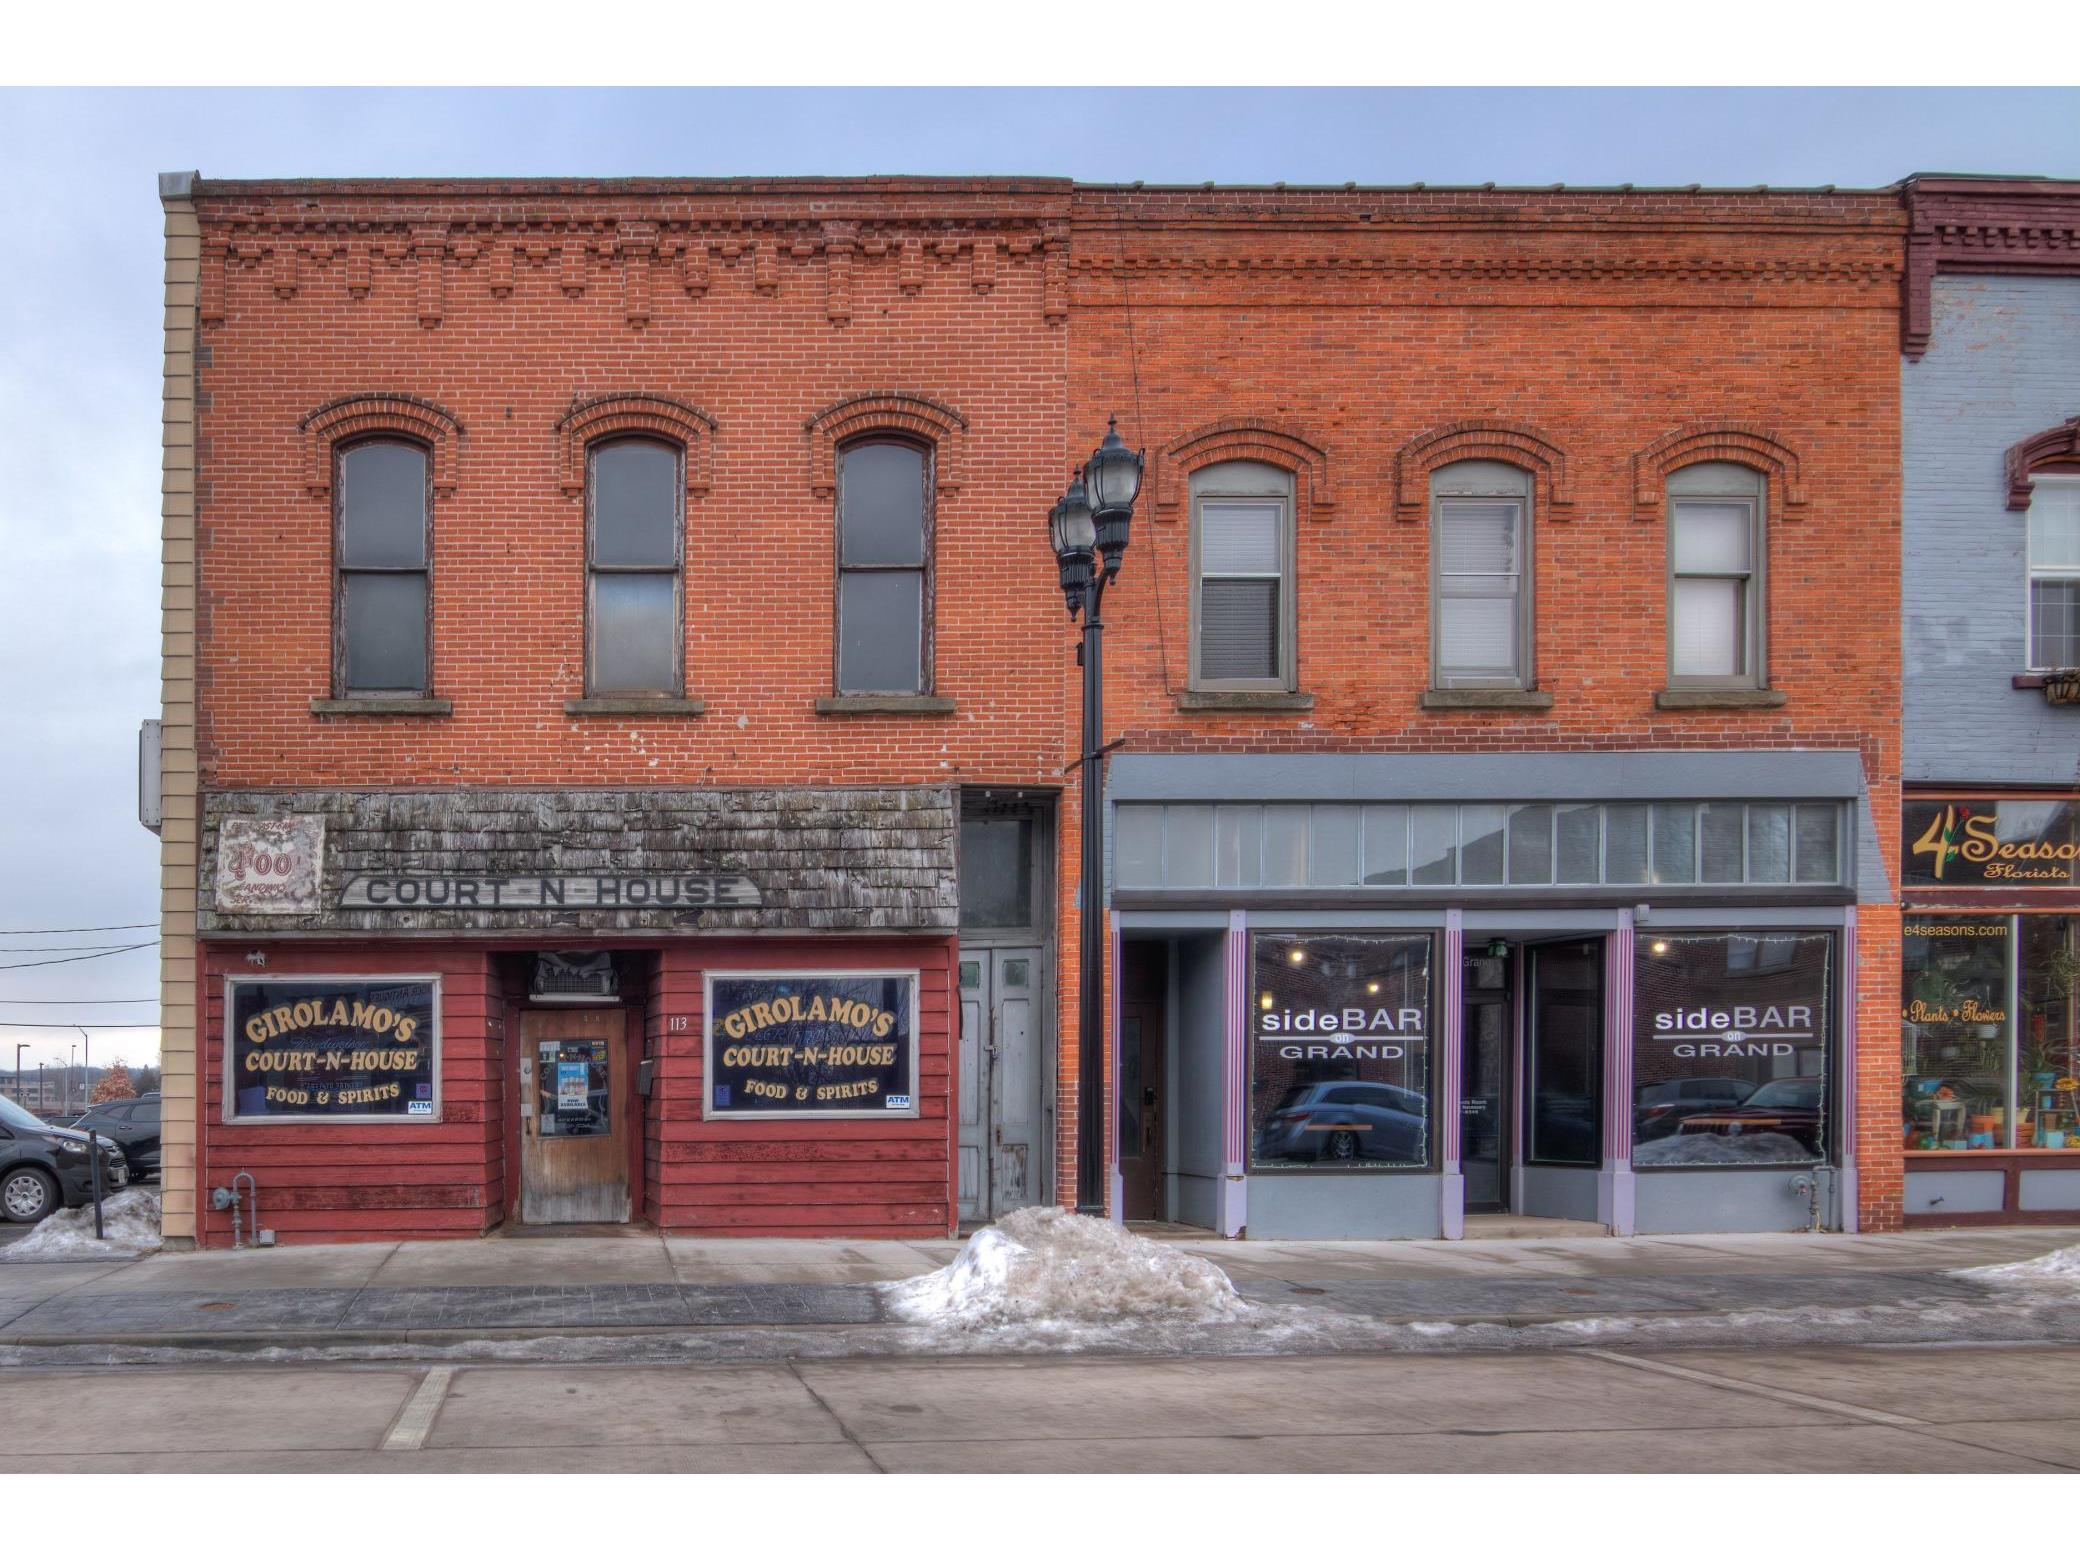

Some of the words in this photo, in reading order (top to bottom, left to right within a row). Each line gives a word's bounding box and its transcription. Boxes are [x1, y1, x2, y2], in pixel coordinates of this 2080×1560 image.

[1912, 804, 1959, 879] 4
[1961, 816, 2080, 862] Seaso
[1983, 863, 2071, 879] Florists
[1904, 925, 2008, 936] e4seasons.com
[245, 1000, 417, 1043] GIROLAMO'S
[723, 995, 894, 1039] GIROLAMO'S
[1262, 1008, 1422, 1031] sideBAR
[1655, 1006, 1811, 1029] sideBAR
[1910, 1000, 1949, 1023] Plants
[1961, 1000, 2006, 1023] Flowers
[670, 1016, 687, 1031] 113
[1335, 1034, 1350, 1043] on
[1727, 1032, 1741, 1041] on
[723, 1046, 895, 1067] COURT-N-HOUSE
[1279, 1046, 1404, 1059] GRAND
[1673, 1044, 1794, 1057] GRAND
[245, 1051, 418, 1071] COURT-N-HOUSE
[266, 1086, 308, 1105] FOOD
[316, 1091, 329, 1105] &
[338, 1084, 400, 1105] SPIRITS
[744, 1080, 787, 1099] FOOD
[795, 1087, 808, 1100] &
[817, 1080, 878, 1100] SPIRITS
[887, 1096, 909, 1104] ATM
[409, 1102, 432, 1110] ATM
